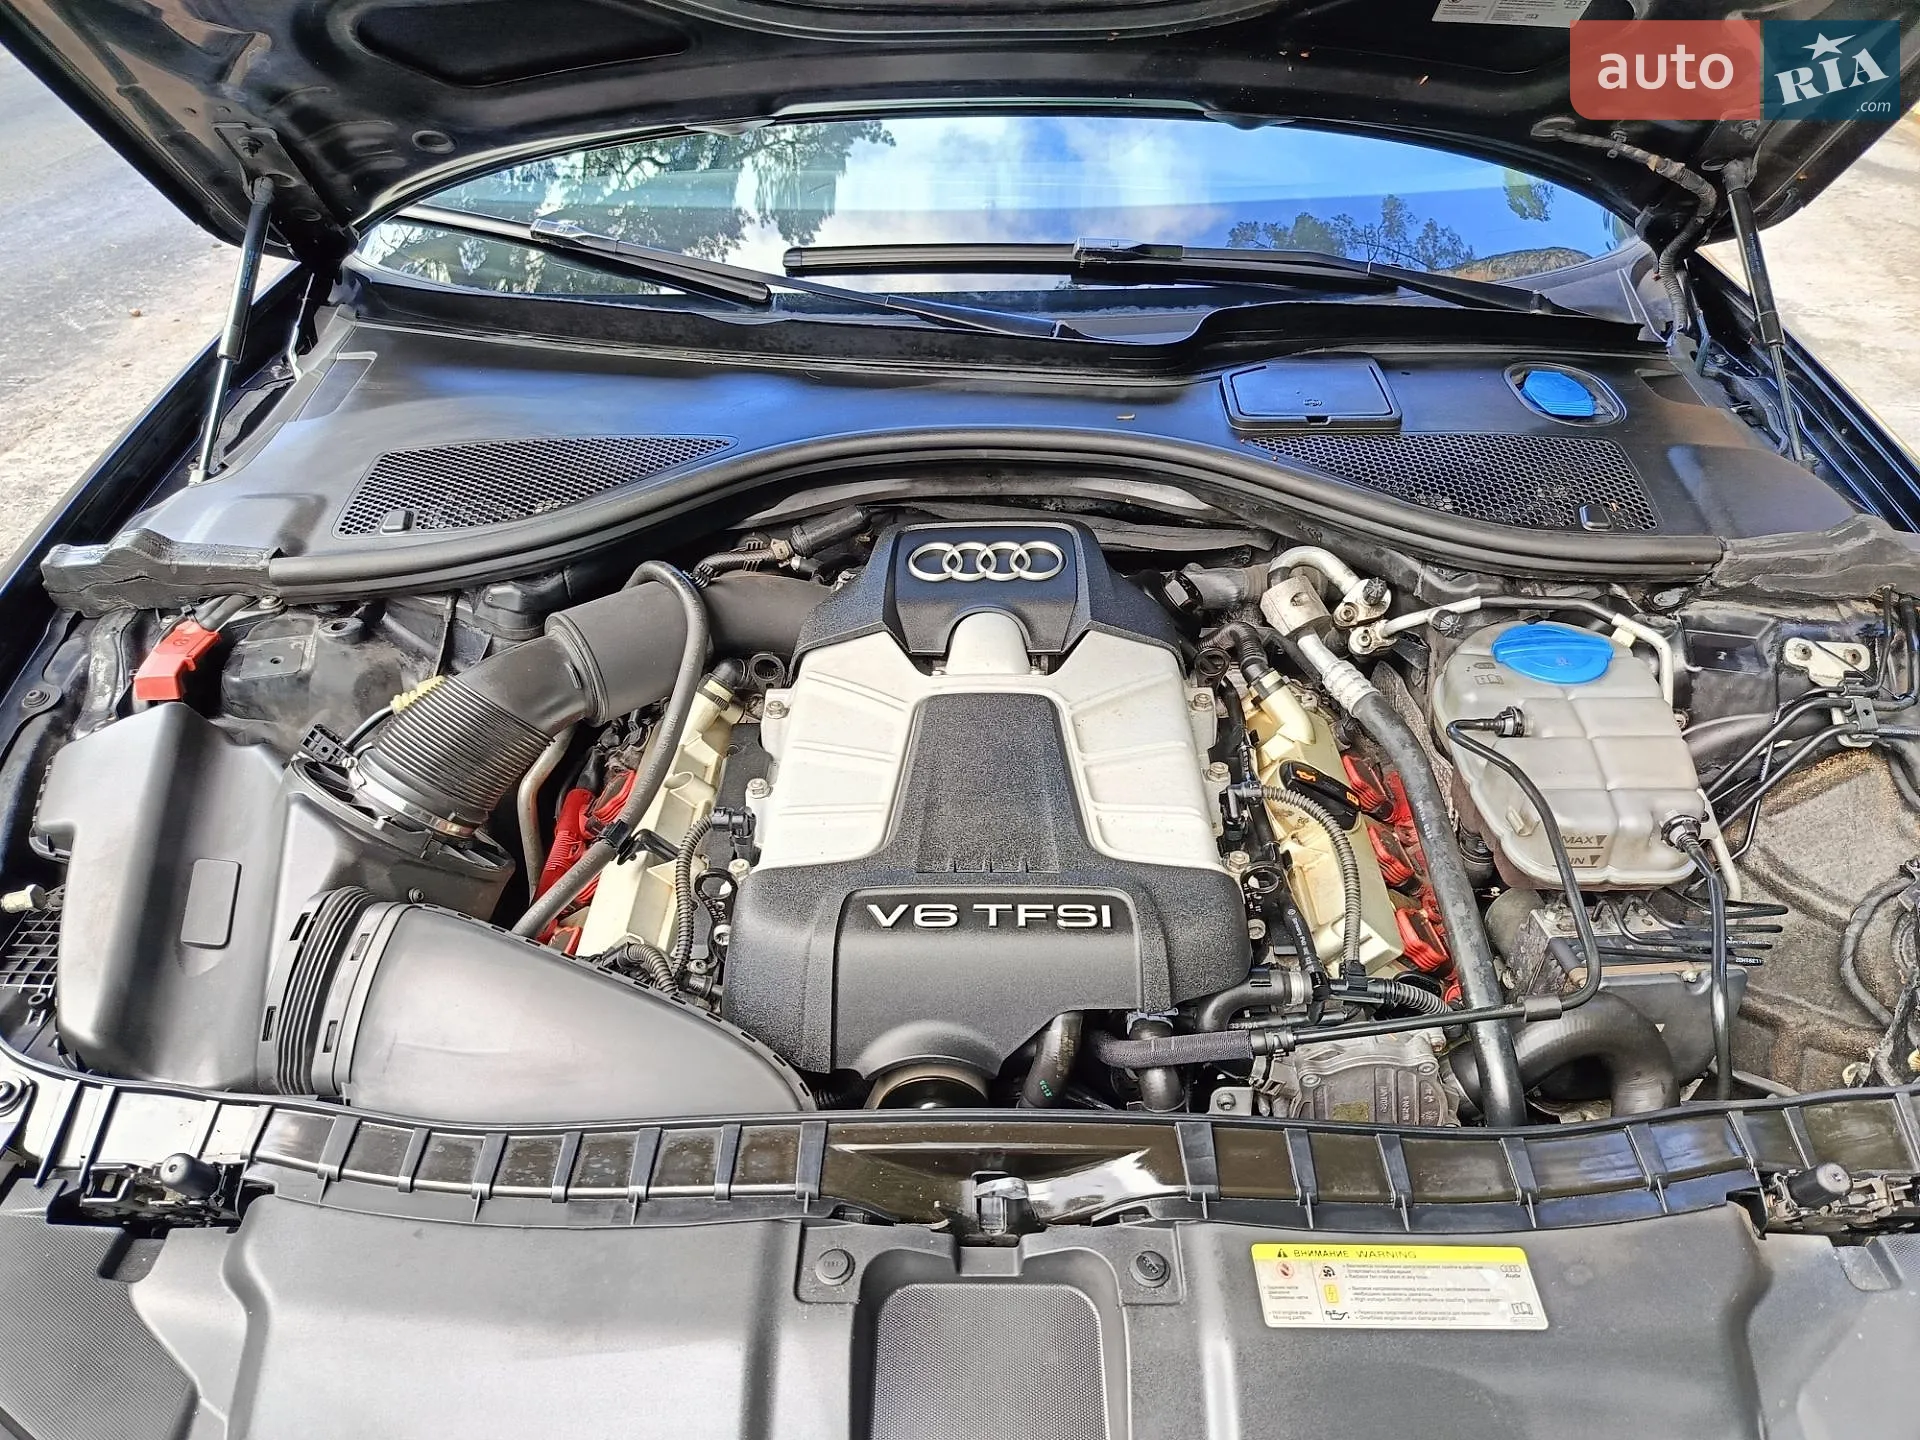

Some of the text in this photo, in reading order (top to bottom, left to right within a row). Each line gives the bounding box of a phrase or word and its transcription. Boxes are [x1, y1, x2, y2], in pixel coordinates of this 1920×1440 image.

[1561, 835, 1593, 844] MAX
[1569, 857, 1585, 865] IN
[867, 904, 1112, 928] V6 TFSI
[1293, 1249, 1417, 1259] ВНИМАНИЕ WARNING
